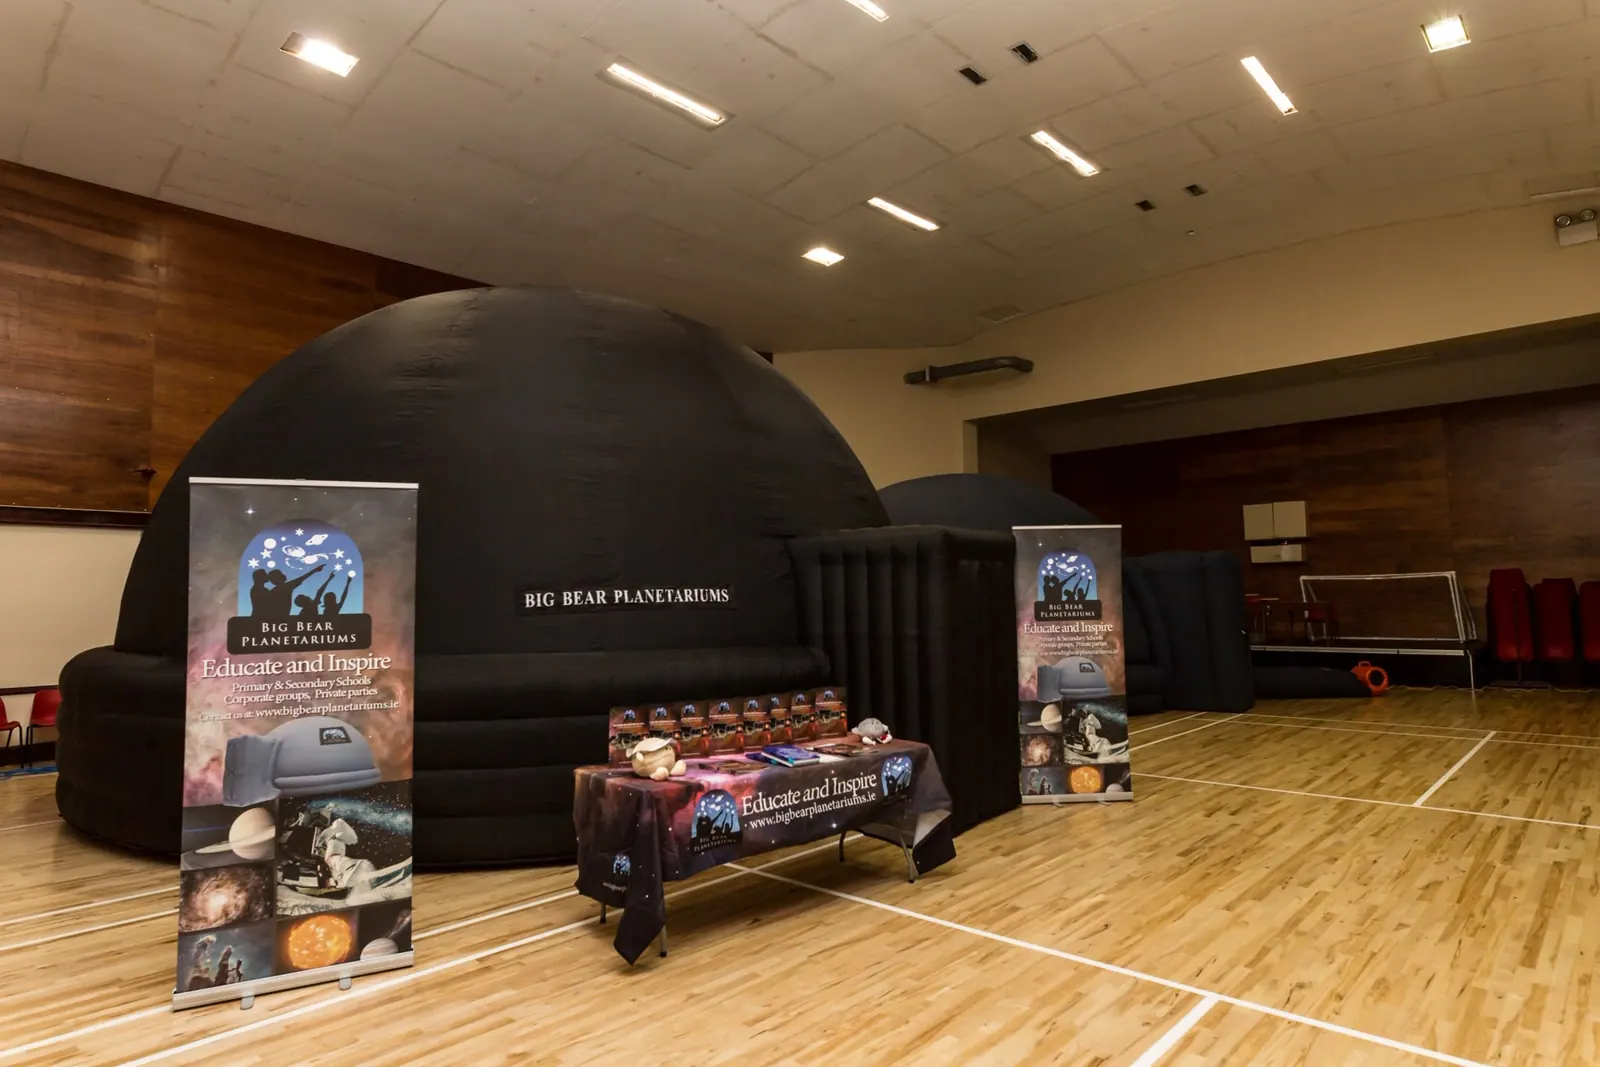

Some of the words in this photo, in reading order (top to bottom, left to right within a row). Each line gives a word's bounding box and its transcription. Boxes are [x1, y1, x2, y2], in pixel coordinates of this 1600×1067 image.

[525, 592, 555, 608] BIG
[562, 590, 608, 606] BEAR
[613, 588, 730, 604] PLANETARIUMS
[1040, 610, 1095, 618] PLANETARIUMS
[261, 621, 288, 633] BIG
[296, 621, 334, 632] BEAR
[1023, 623, 1060, 634] Educate
[1061, 621, 1079, 633] and
[1081, 621, 1113, 635] Inspire
[241, 633, 357, 647] PLANETARIUMS
[201, 657, 284, 678] Educate
[286, 654, 324, 673] and
[328, 653, 392, 675] Inspire
[232, 682, 273, 694] Primary
[274, 680, 284, 690] &
[285, 677, 335, 690] Secondary
[336, 675, 372, 687] Schools
[223, 694, 275, 706] Corporate
[275, 692, 311, 704] groups,
[315, 688, 347, 699] Private
[348, 687, 378, 699] parties
[255, 700, 400, 718] www.bigbearplanetariums.ie
[741, 788, 801, 817] Educate
[802, 778, 829, 802] and
[831, 773, 877, 794] Inspire
[749, 791, 876, 831] www.bigbearplanetariums.ie
